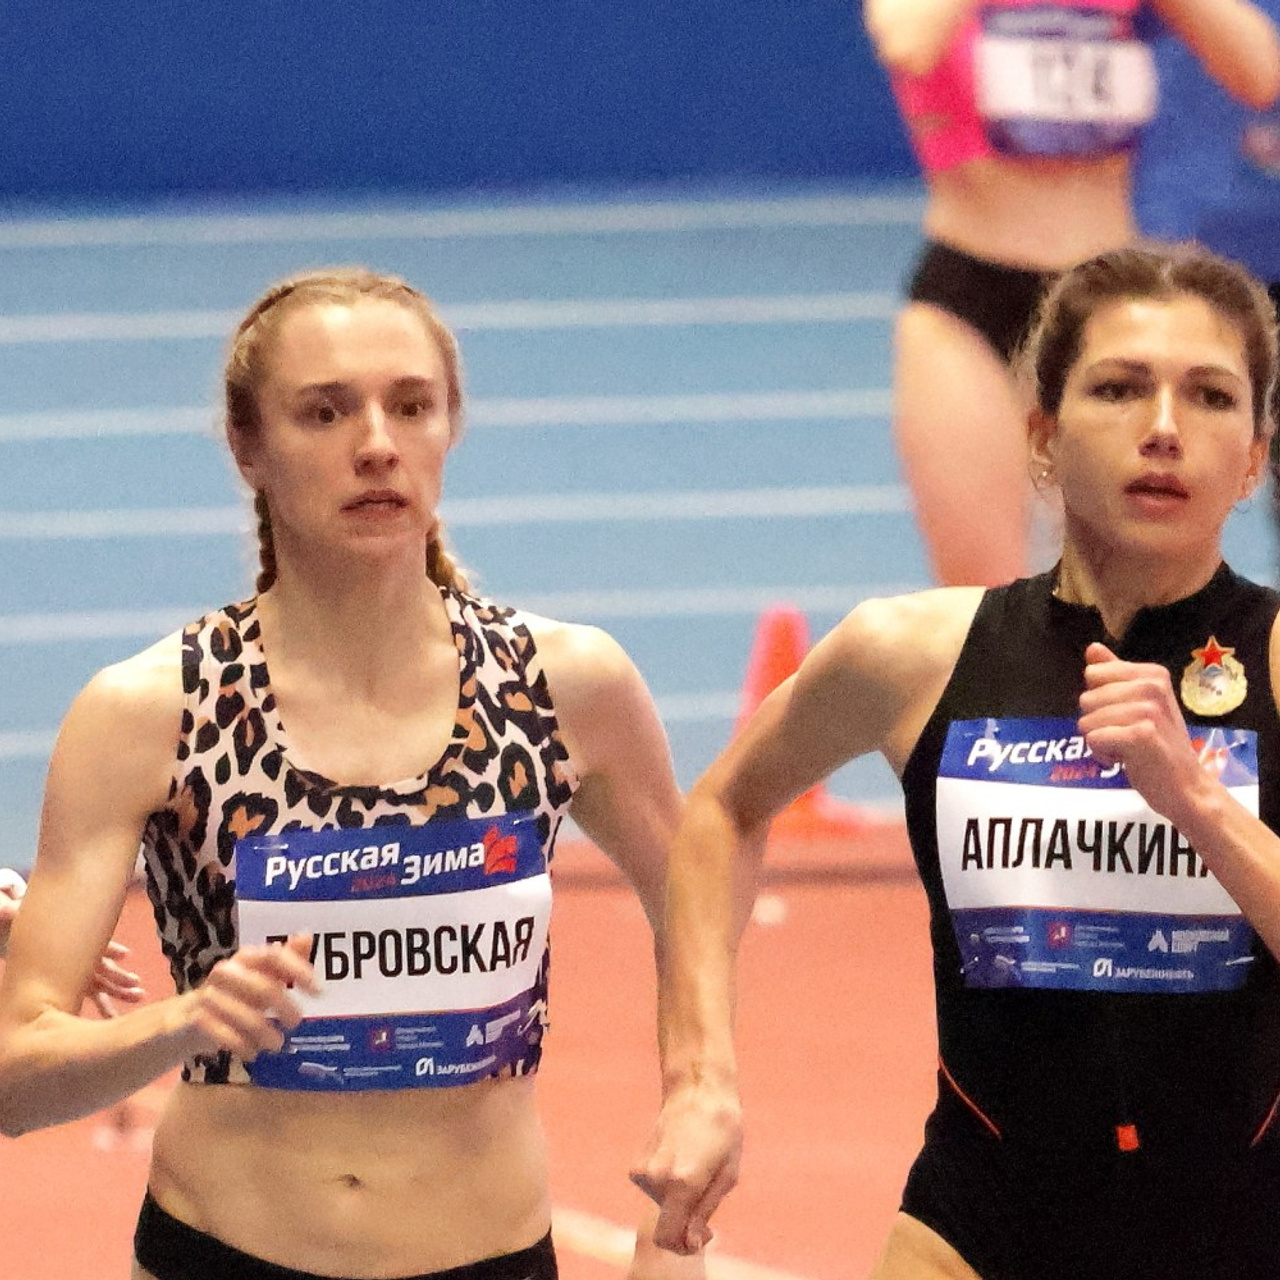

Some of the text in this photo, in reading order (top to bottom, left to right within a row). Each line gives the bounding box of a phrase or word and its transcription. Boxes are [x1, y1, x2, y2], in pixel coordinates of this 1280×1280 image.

[265, 842, 401, 891] Русская
[401, 842, 486, 886] Зима
[961, 817, 1208, 878] АПЛАЧКИН
[265, 916, 535, 989] БРОВСКАЯ
